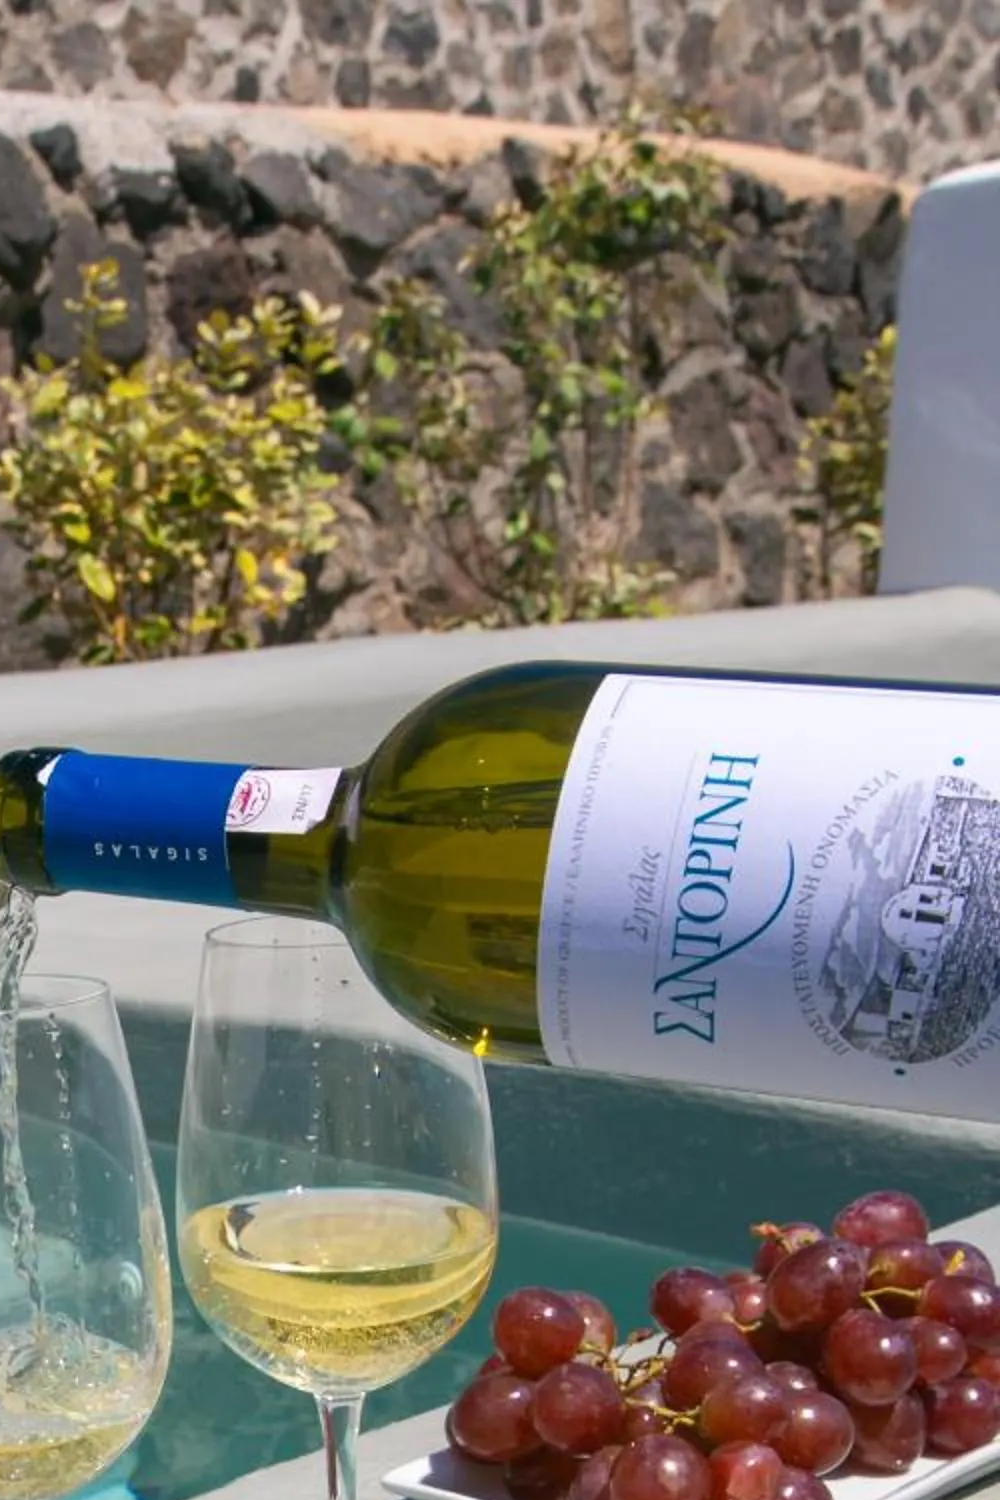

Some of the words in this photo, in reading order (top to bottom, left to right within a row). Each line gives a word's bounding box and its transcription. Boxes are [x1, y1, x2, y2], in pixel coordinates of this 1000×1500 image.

[93, 841, 208, 861] SIGALAS
[810, 769, 899, 870] ΟΝΟΜΑΣΙΑ
[622, 845, 662, 943] Σιγάλας
[653, 752, 795, 1044] ΣΑΝΤΟΡΙΝΗ
